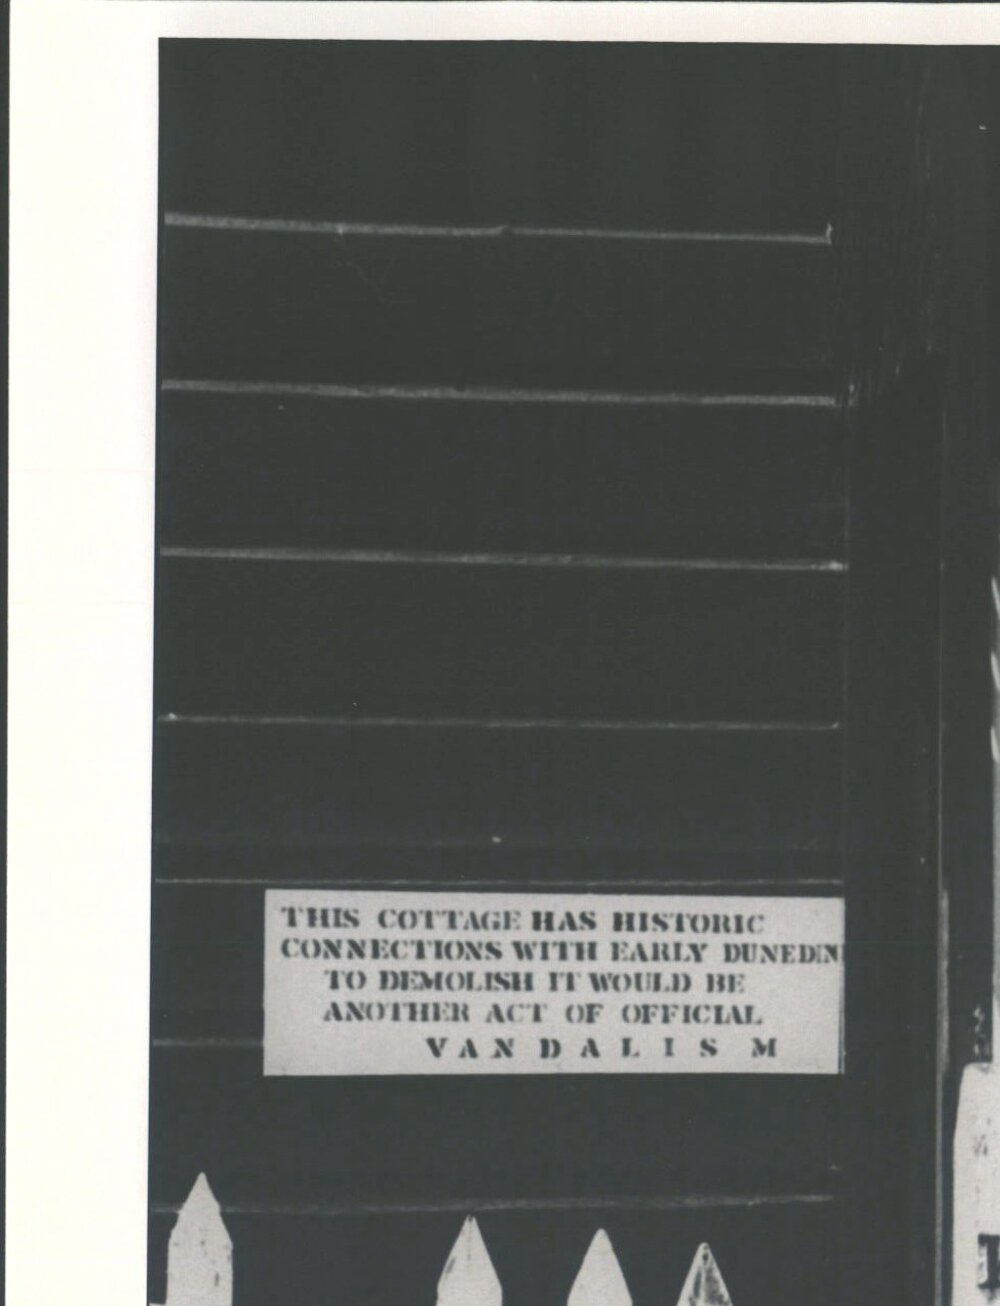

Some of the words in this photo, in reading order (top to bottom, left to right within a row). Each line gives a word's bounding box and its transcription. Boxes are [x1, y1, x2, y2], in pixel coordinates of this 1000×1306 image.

[280, 906, 360, 929] THIS
[377, 909, 521, 931] COTTAGE
[531, 911, 597, 932] HAS
[612, 912, 765, 934] HISTORIC
[281, 938, 503, 960] CONNECTIONS
[512, 940, 598, 962] WITH
[611, 942, 708, 963] EARLY
[323, 970, 367, 991] TO
[379, 970, 534, 992] DEMOLISH
[549, 971, 580, 992] IT
[590, 972, 692, 993] WOULD
[706, 973, 746, 993] BE
[323, 1001, 470, 1023] ANOTHER
[485, 1003, 547, 1024] ACT
[565, 1003, 602, 1025] OF
[622, 1004, 763, 1026] OFFICIAL
